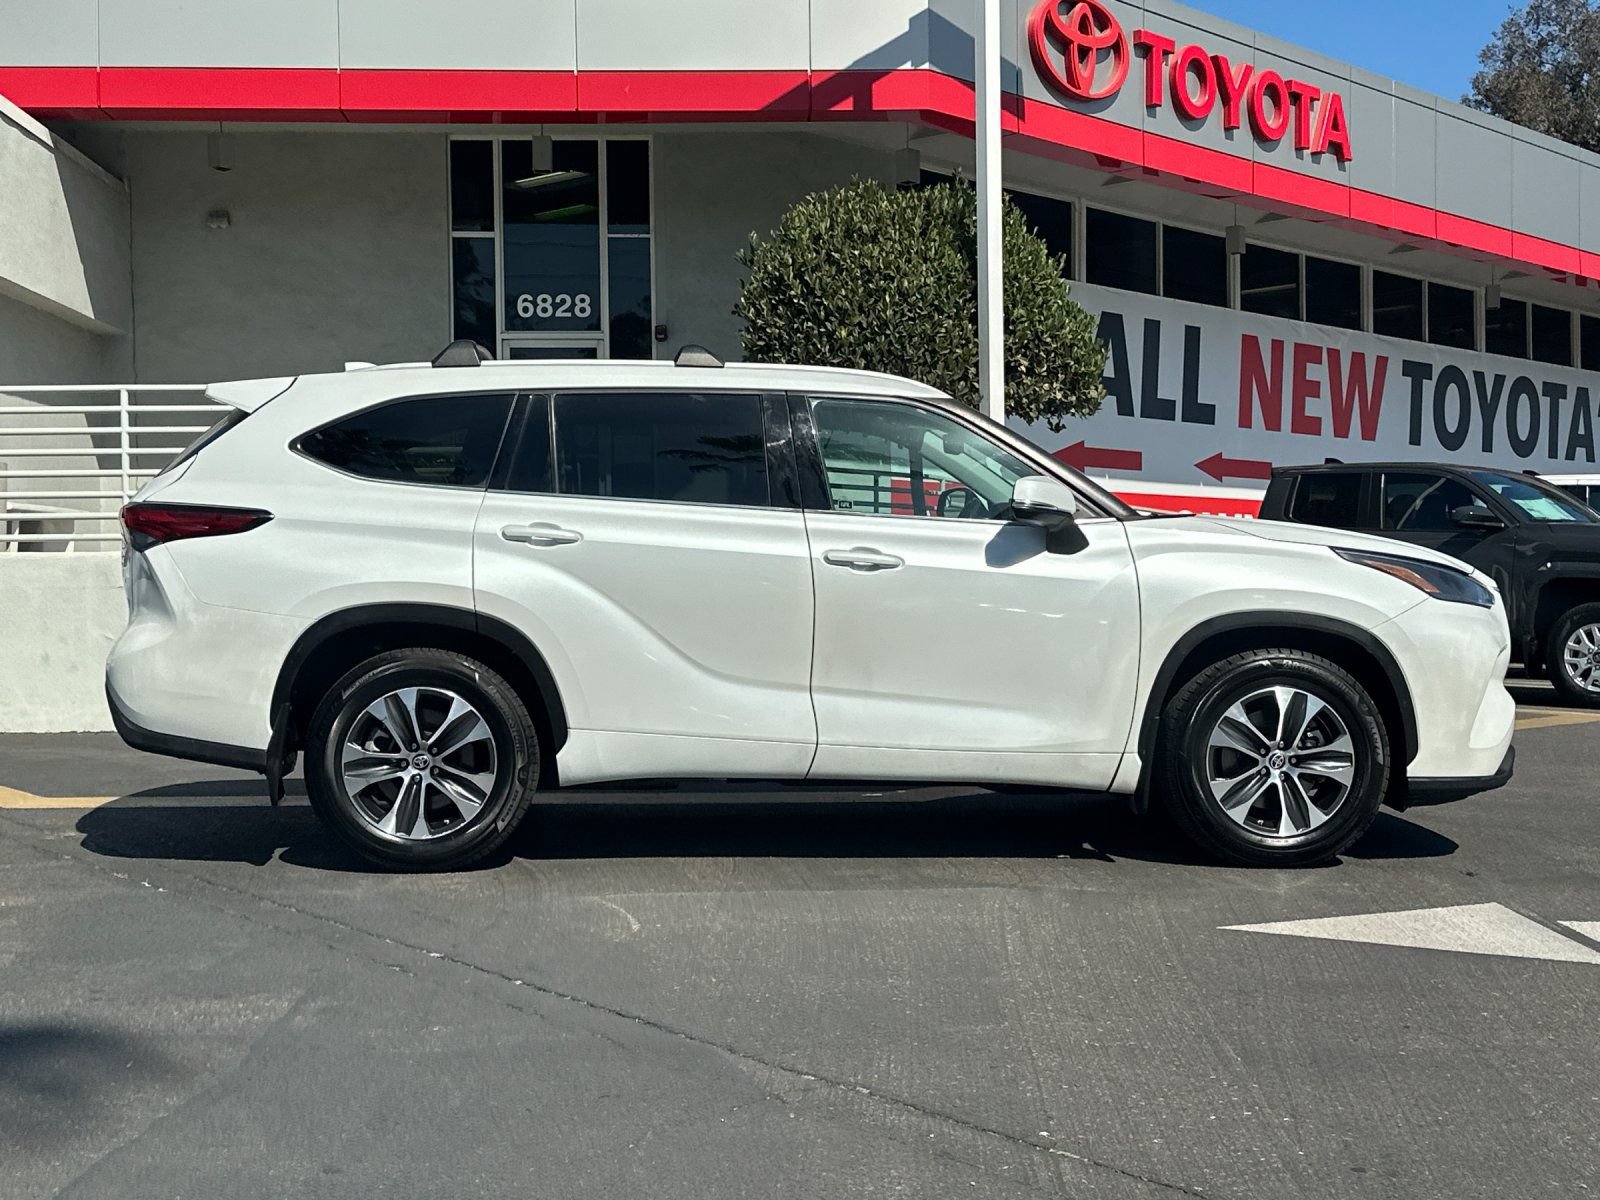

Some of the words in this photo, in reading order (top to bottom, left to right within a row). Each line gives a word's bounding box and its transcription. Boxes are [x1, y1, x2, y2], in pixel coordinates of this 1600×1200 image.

[1133, 29, 1352, 161] TOYOTA
[517, 294, 591, 318] 6828
[1094, 311, 1216, 425] ALL
[1238, 333, 1389, 442] NEW
[1402, 359, 1600, 463] TOYOTA
